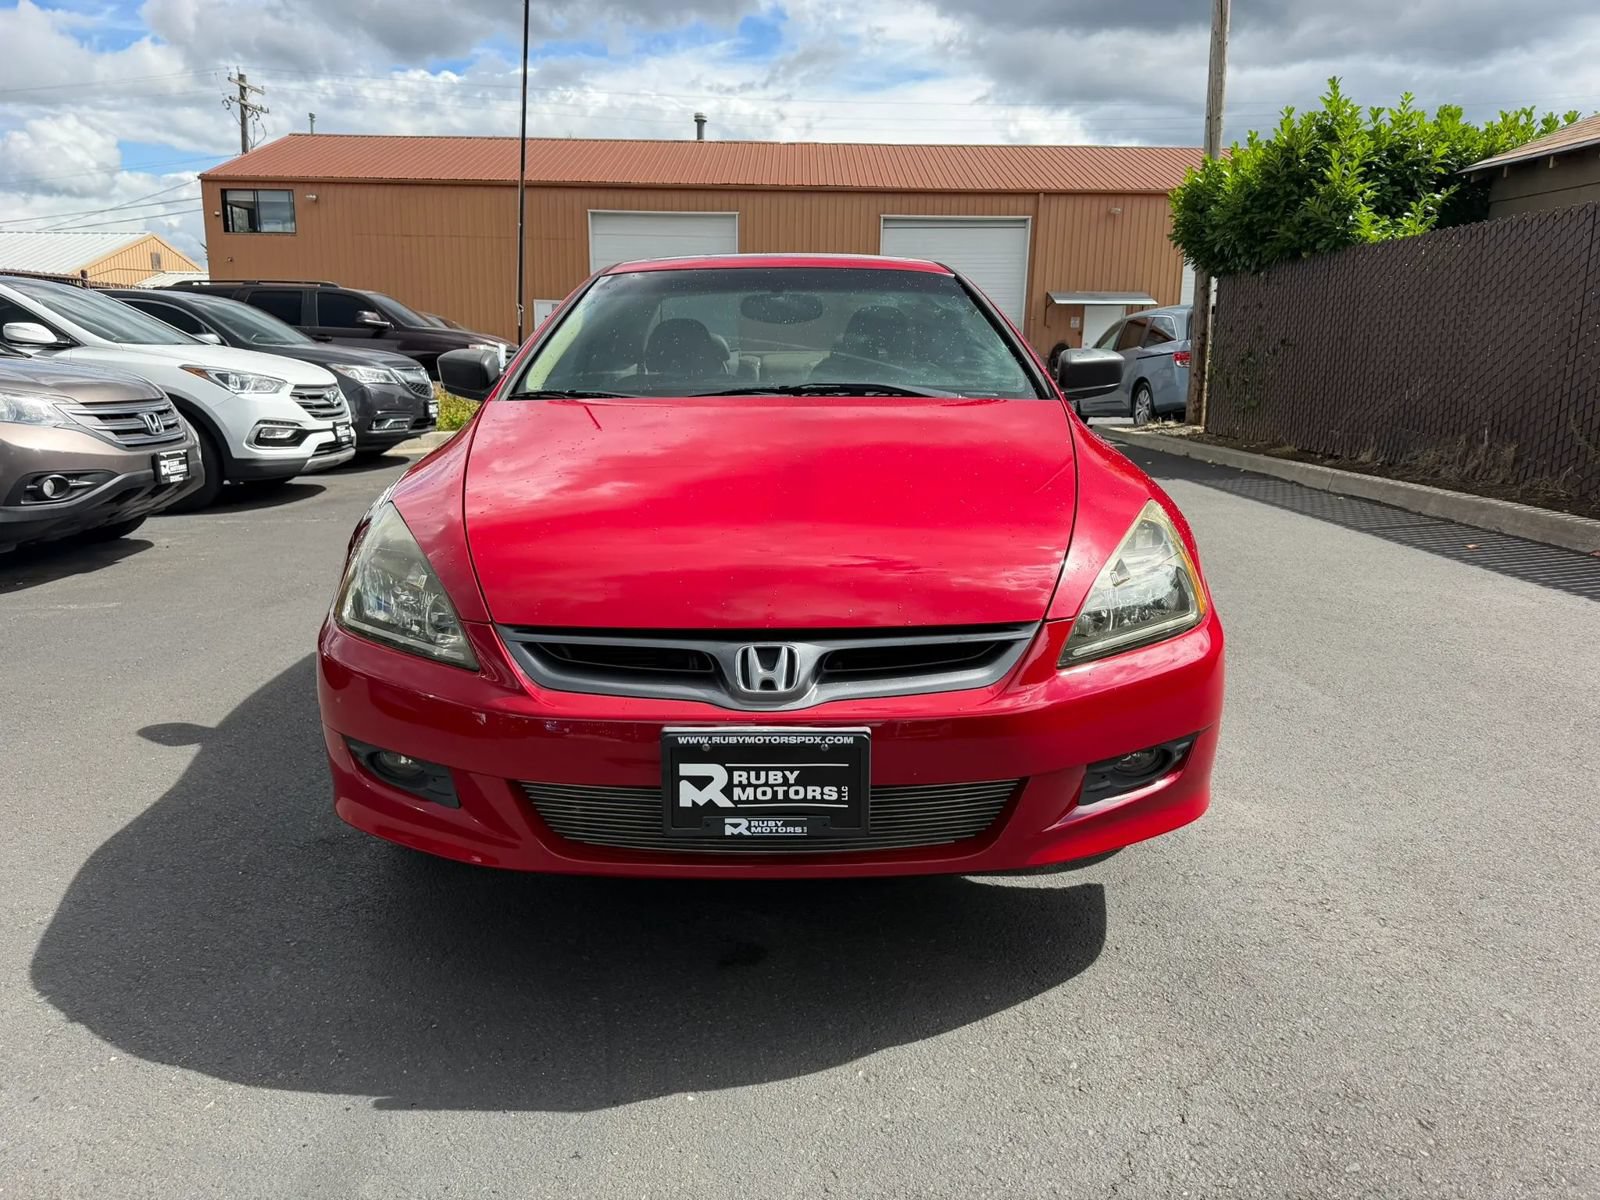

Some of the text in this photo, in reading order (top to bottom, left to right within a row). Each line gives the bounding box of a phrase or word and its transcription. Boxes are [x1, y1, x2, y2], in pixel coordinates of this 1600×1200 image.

[677, 736, 854, 745] WWW.RUBYMOTORSPDX.COM
[733, 770, 801, 785] RUBY
[733, 786, 839, 801] MOTORS
[841, 786, 849, 801] LLC
